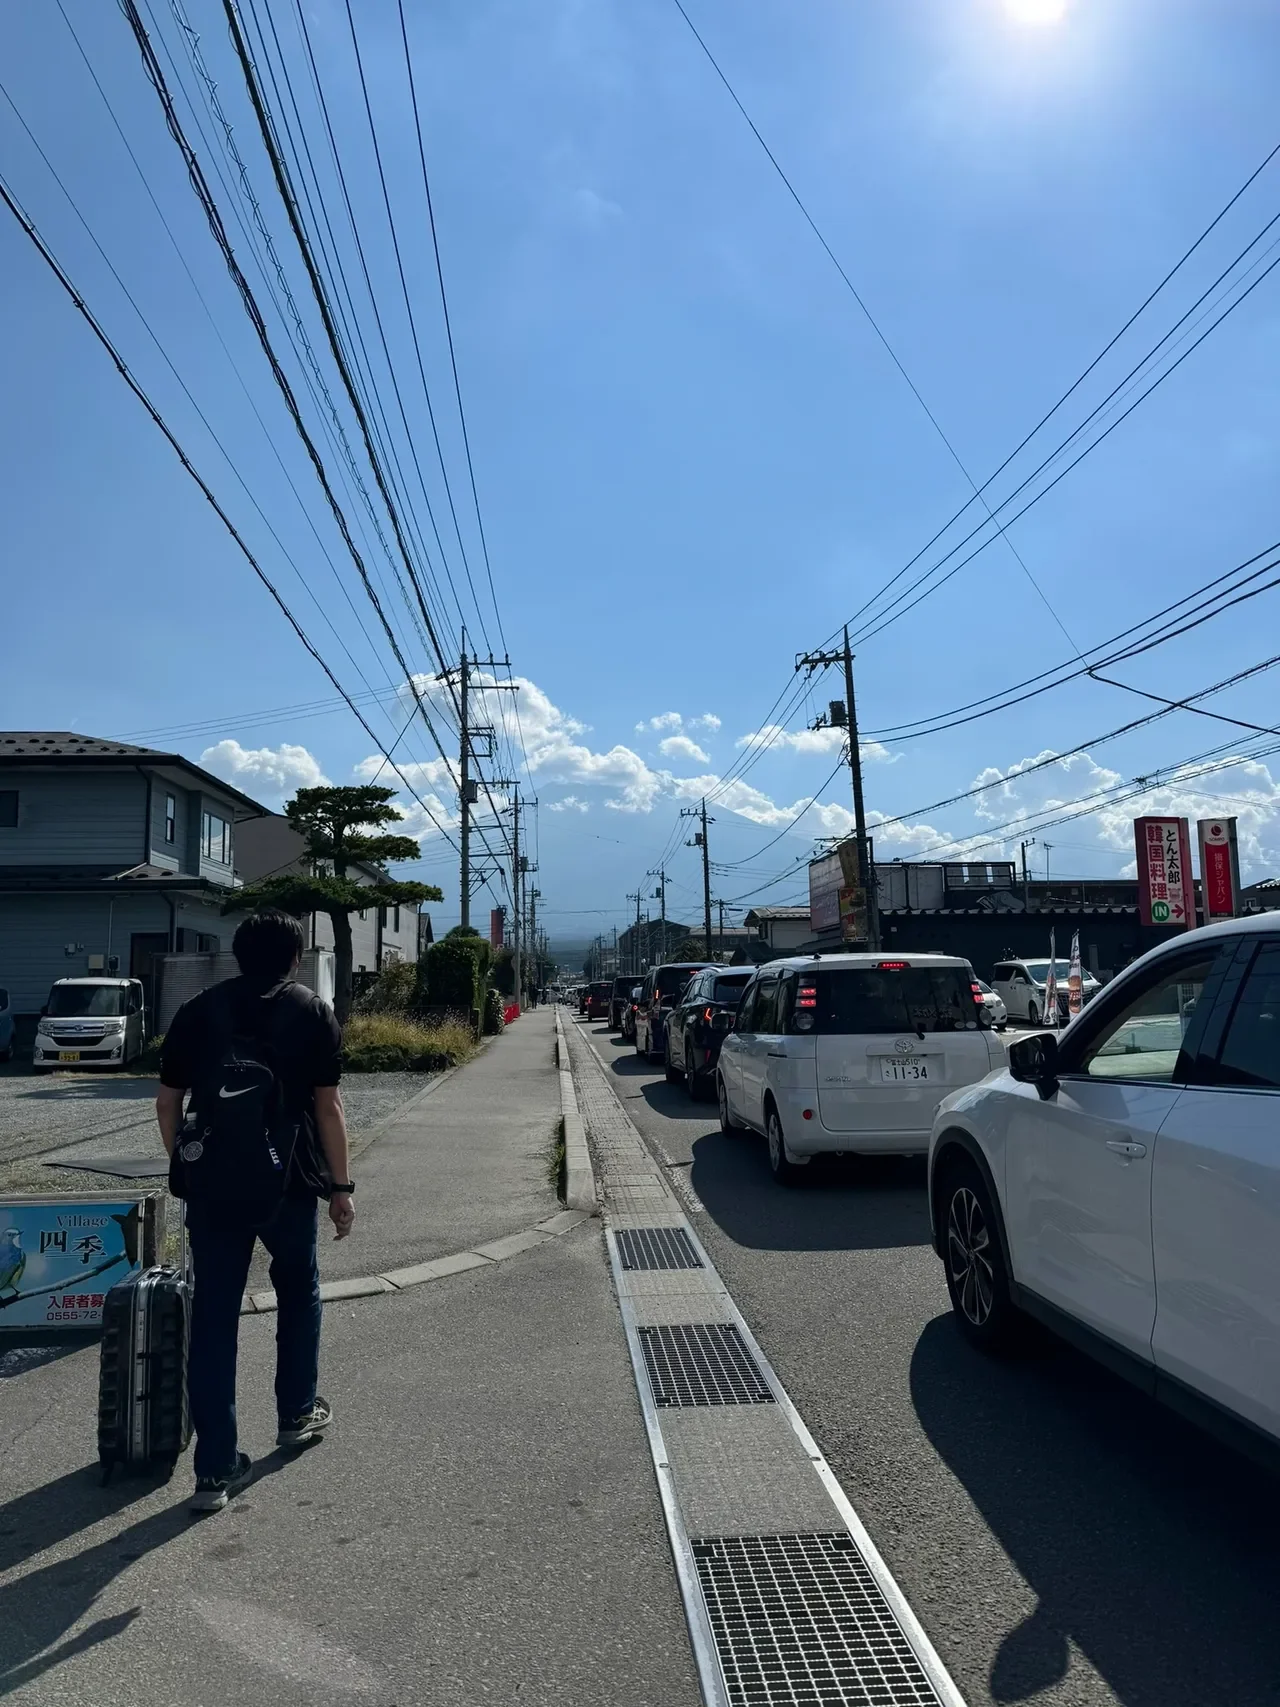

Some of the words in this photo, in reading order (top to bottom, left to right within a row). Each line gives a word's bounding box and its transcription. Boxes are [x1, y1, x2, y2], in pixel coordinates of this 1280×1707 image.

[1147, 825, 1168, 900] 韓国料理
[1166, 830, 1181, 884] とん太郎
[1214, 853, 1226, 904] 損保ジャパン
[1154, 907, 1168, 917] IN
[893, 1066, 928, 1080] 11-34
[56, 1214, 109, 1228] Village
[39, 1230, 107, 1264] 四季
[46, 1310, 103, 1321] 0555-72-
